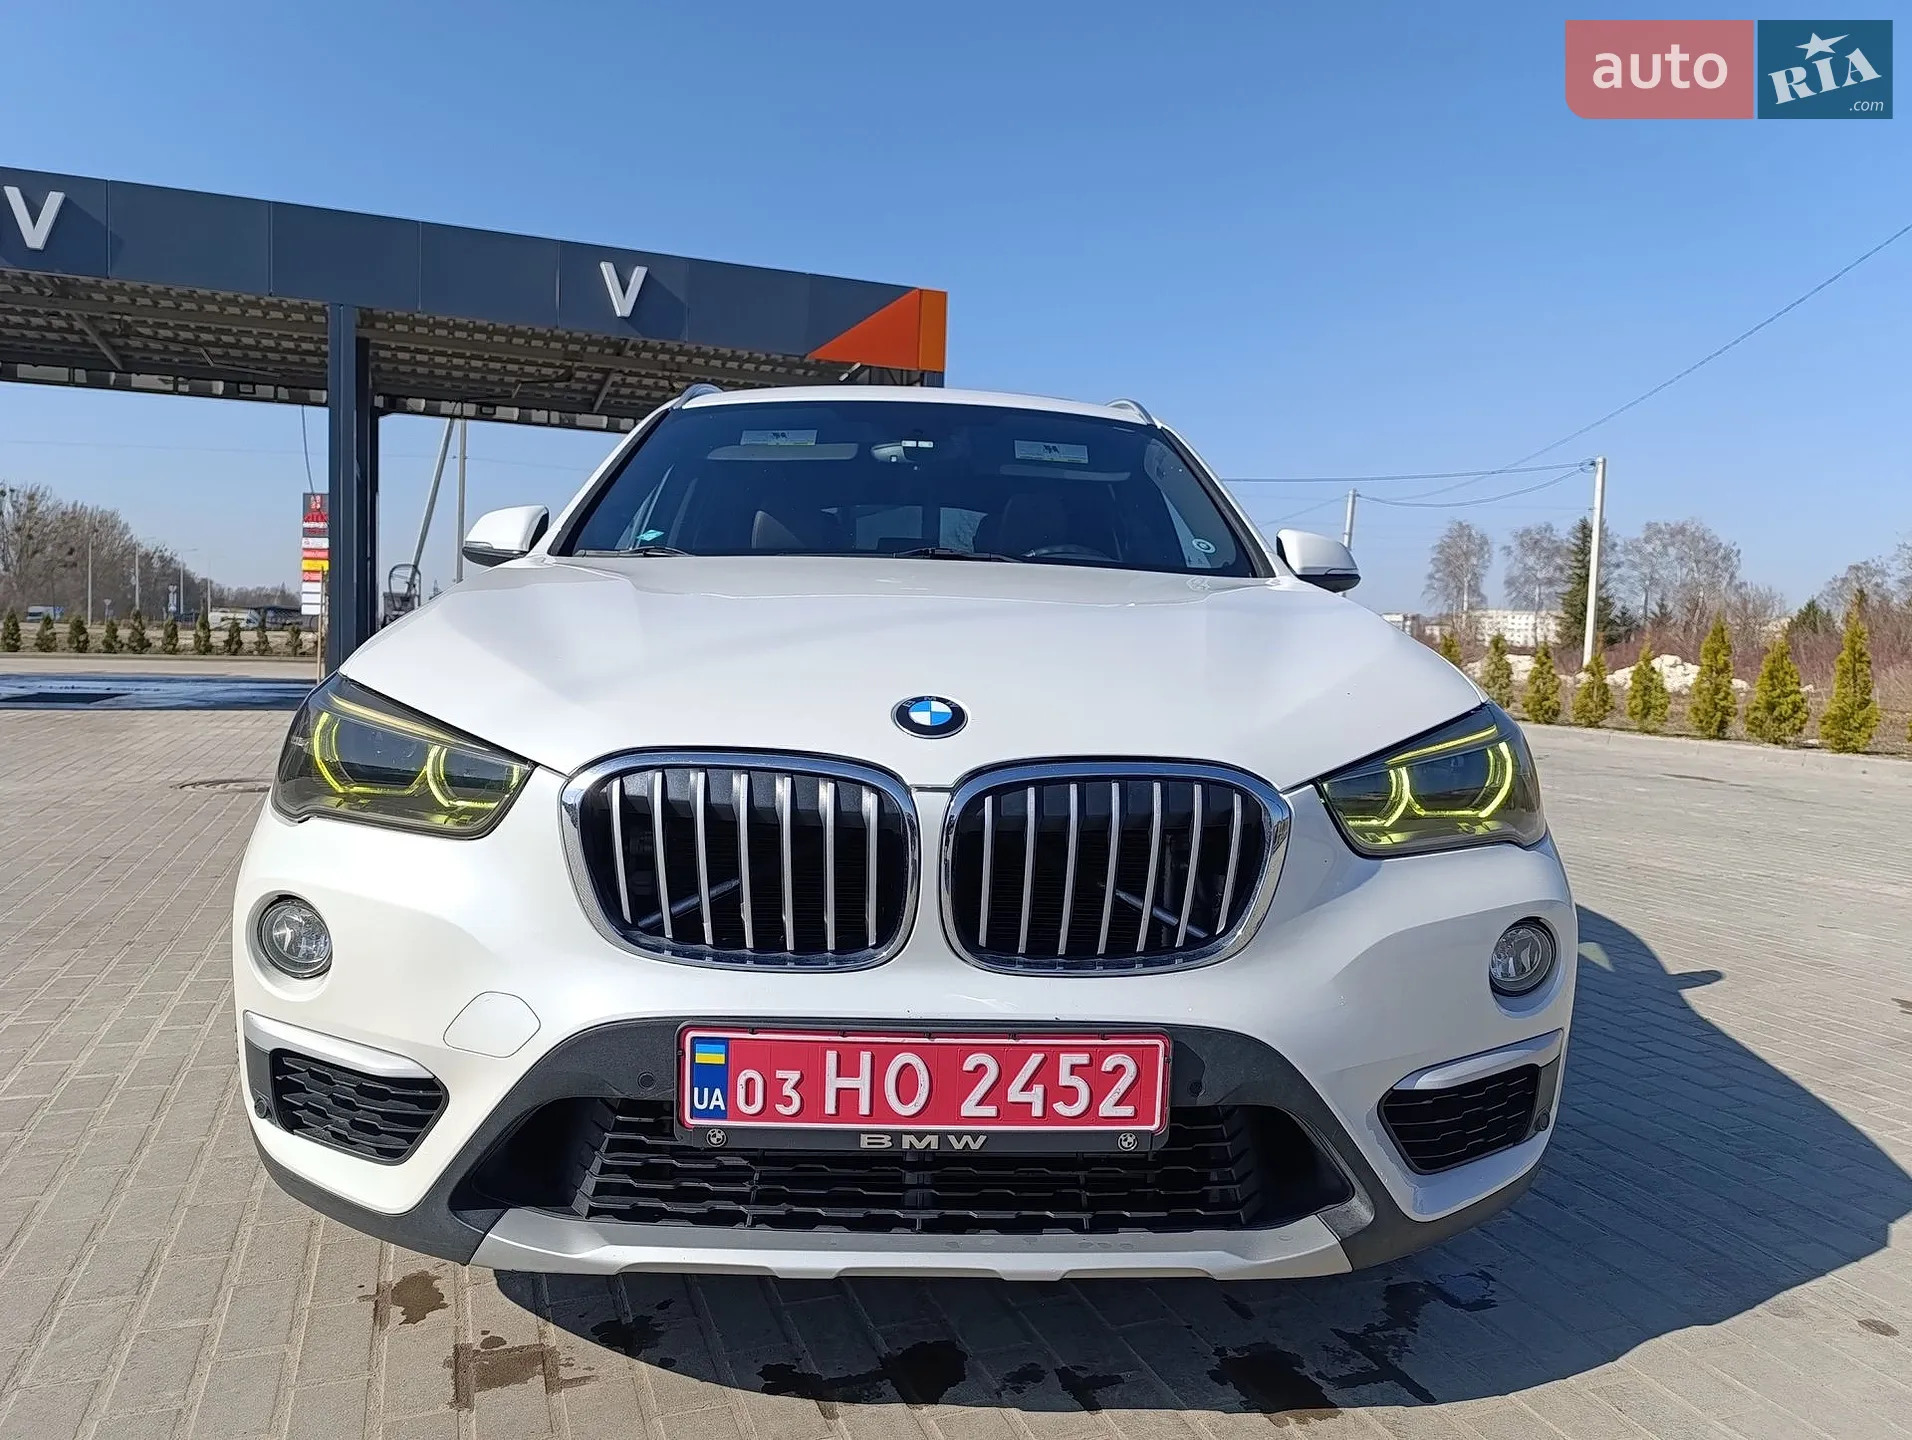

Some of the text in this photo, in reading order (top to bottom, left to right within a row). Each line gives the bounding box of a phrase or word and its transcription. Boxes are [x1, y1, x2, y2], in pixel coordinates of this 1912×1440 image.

[902, 695, 959, 708] BMW
[736, 1050, 1138, 1117] 03 HO 2452
[693, 1087, 725, 1111] UA
[860, 1133, 987, 1150] BMW
